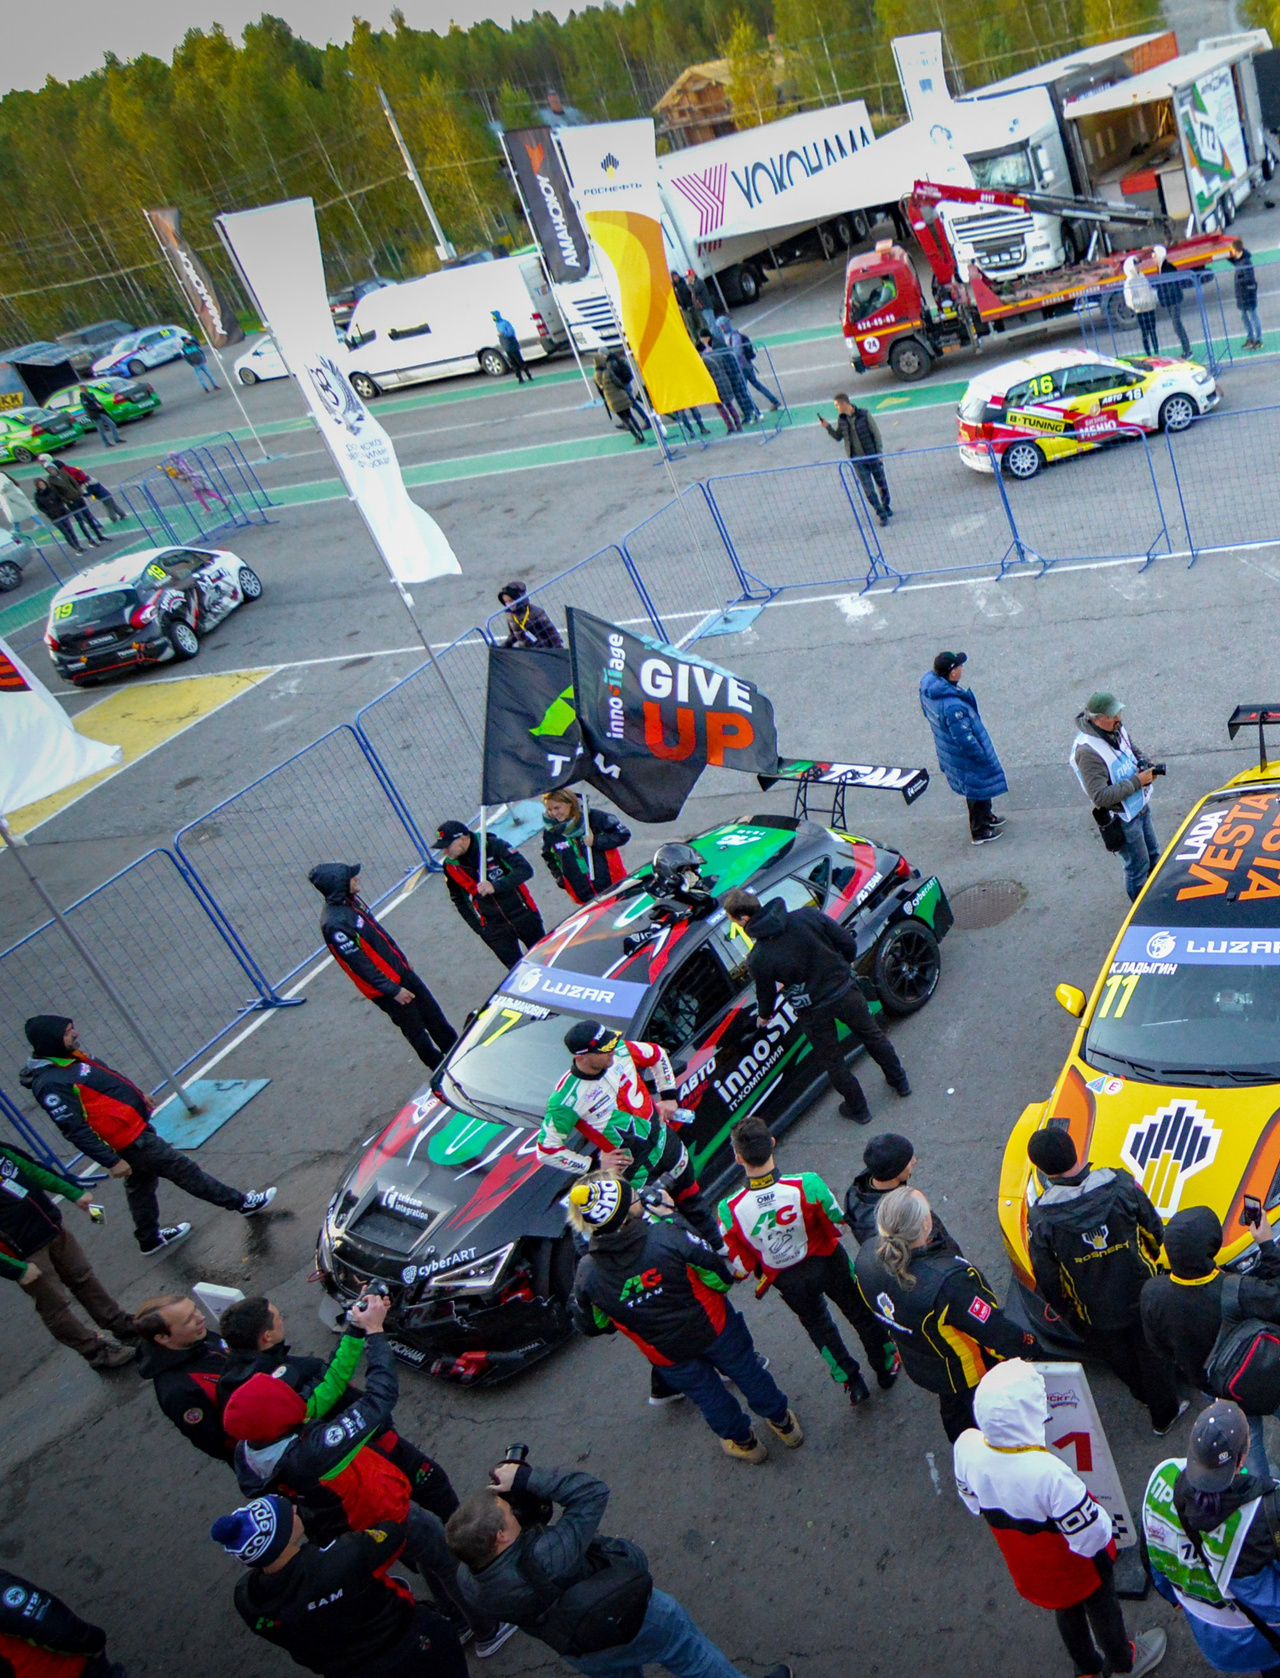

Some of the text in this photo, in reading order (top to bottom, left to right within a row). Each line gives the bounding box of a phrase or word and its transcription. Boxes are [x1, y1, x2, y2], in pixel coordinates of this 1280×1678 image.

[584, 182, 642, 196] РОСНЕФТЬ
[1029, 375, 1054, 397] 16
[1101, 388, 1142, 406] АВТО 16
[147, 564, 166, 581] 19
[54, 603, 74, 620] 19
[640, 658, 753, 714] GIVE
[643, 700, 755, 767] UP
[1175, 810, 1230, 861] LADA
[1176, 794, 1280, 901] VESTA
[866, 871, 883, 893] TEAM
[912, 875, 938, 907] cyberART
[1109, 962, 1178, 977] К.ЛАДЫГИН
[541, 979, 616, 1004] LUZAR
[1098, 974, 1139, 1019] 11
[679, 1056, 718, 1101] АВТО
[729, 1045, 784, 1111] IT-КОМПАНИЯ
[398, 1193, 423, 1207] telecom
[757, 1193, 775, 1204] OMP
[395, 1202, 429, 1221] integration
[418, 1246, 477, 1276] cyberART
[1074, 1240, 1130, 1264] ROSNEFT
[627, 1286, 664, 1308] TEAM
[1052, 1431, 1093, 1472] 1
[306, 1588, 344, 1611] EAM
